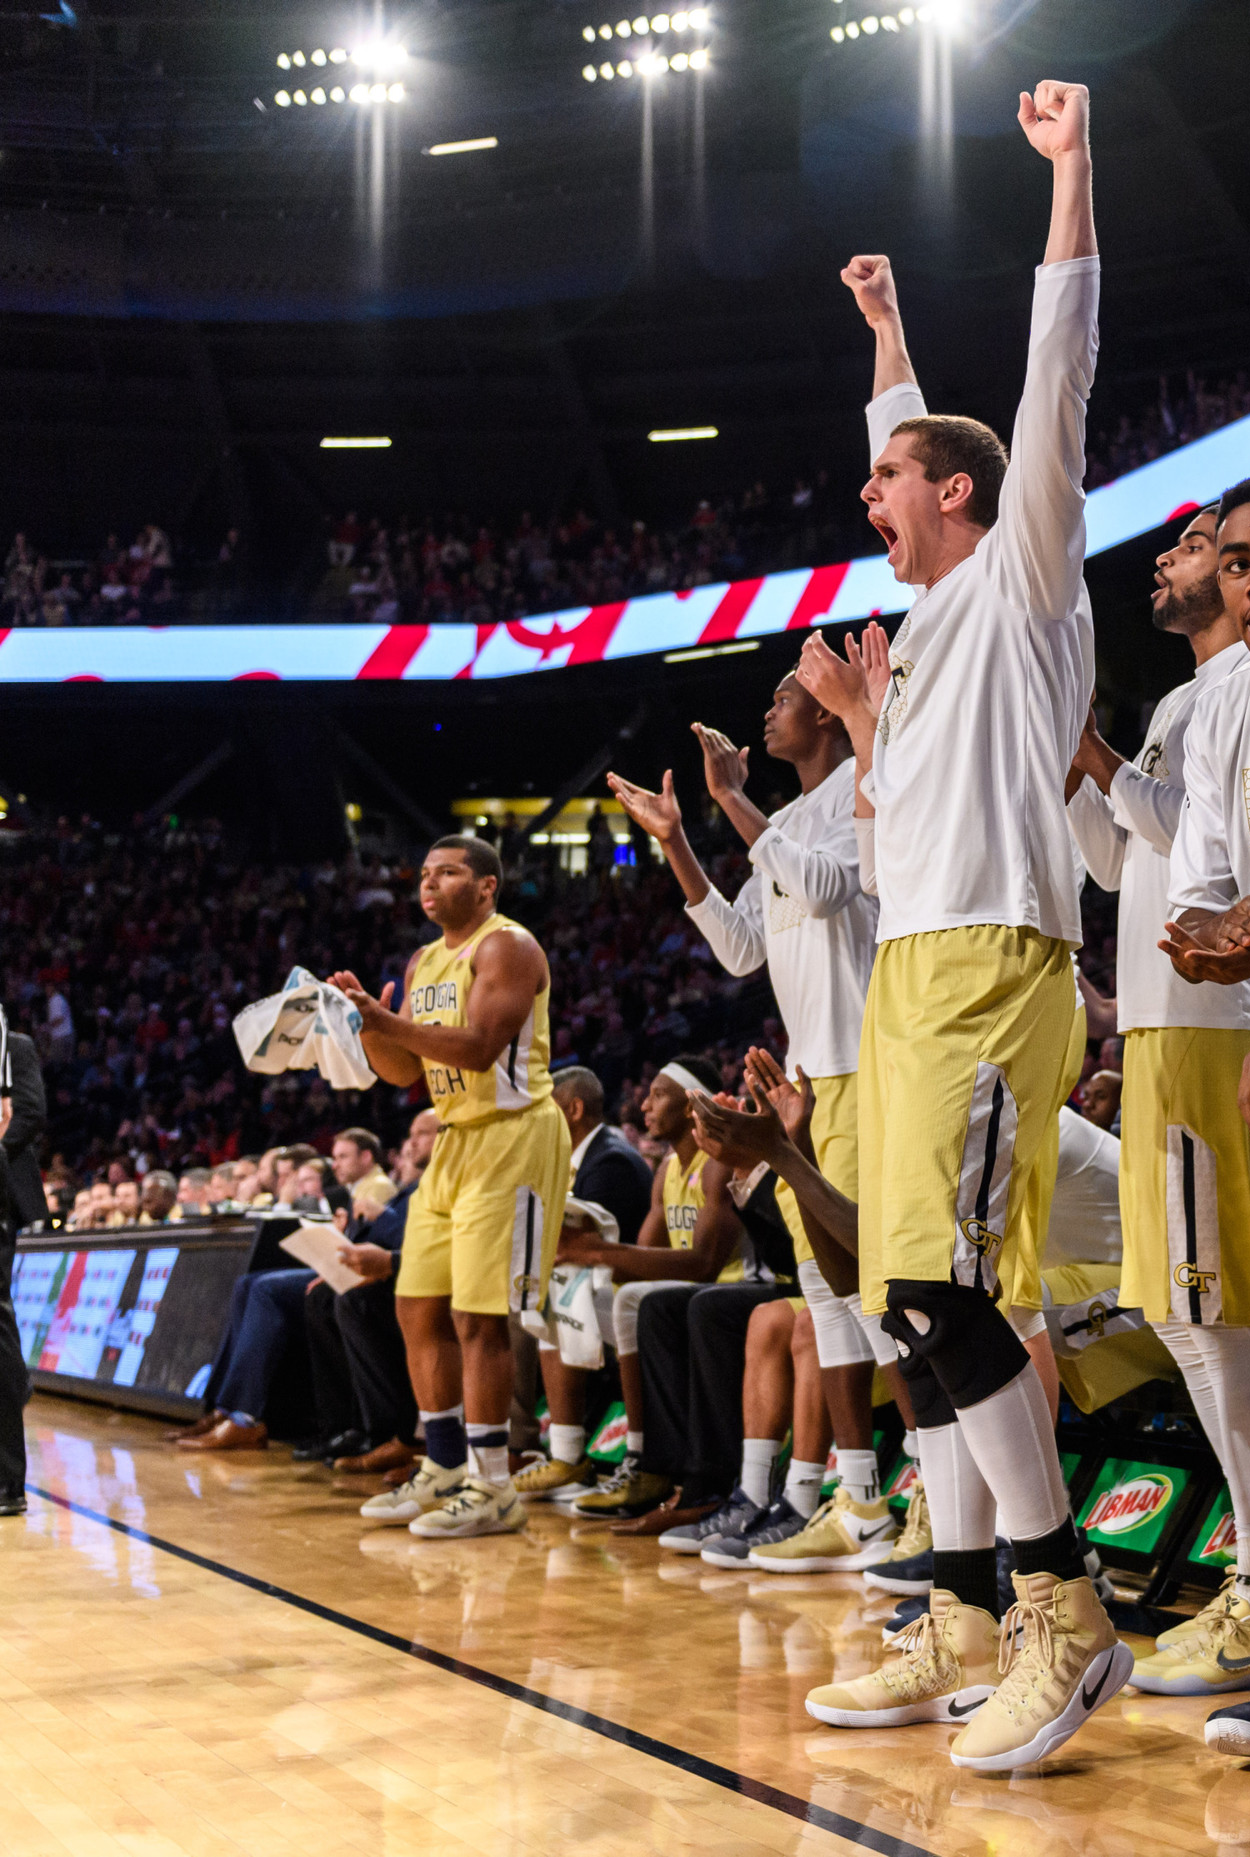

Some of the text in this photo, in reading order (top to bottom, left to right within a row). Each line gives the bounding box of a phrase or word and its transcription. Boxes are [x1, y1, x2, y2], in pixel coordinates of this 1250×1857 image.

[960, 1217, 1003, 1257] GT
[1173, 1261, 1216, 1294] GT
[1083, 1484, 1169, 1531] LIBMAN
